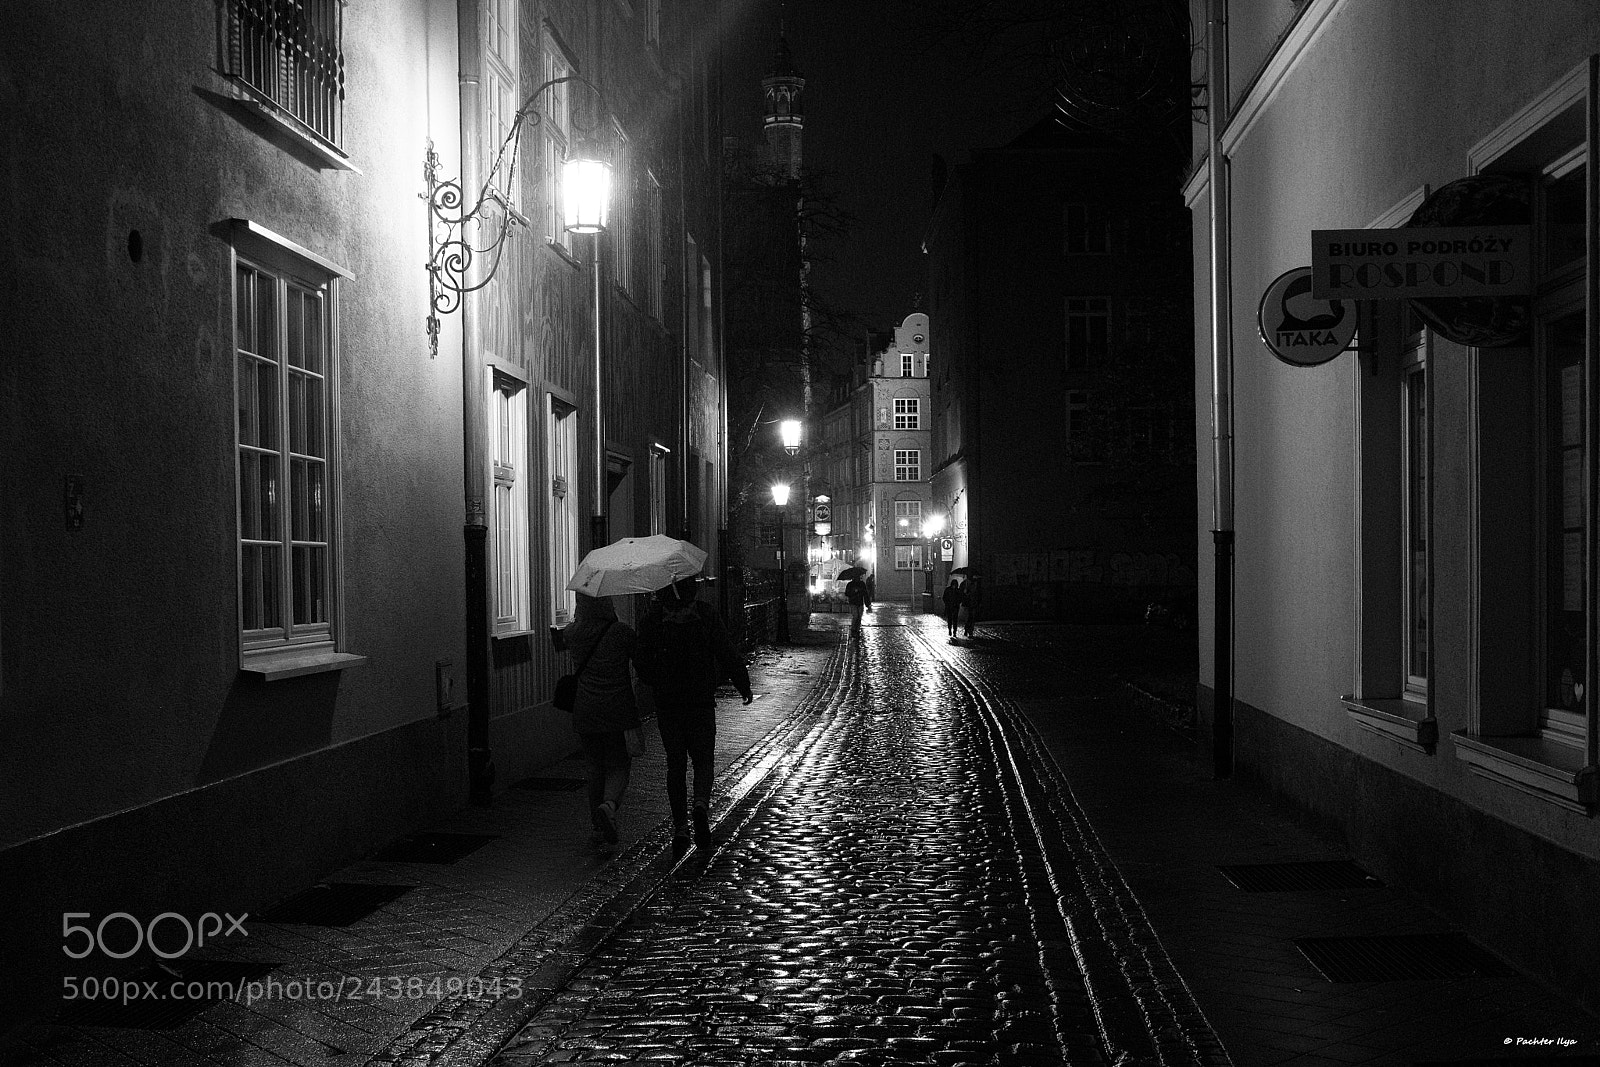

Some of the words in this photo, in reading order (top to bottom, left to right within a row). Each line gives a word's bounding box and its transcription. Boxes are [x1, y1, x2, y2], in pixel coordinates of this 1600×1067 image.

[1328, 241, 1399, 257] BIURO
[1407, 236, 1513, 255] PODRÓŻY
[1328, 260, 1515, 289] ROSPOND
[1276, 331, 1339, 347] ITAKA
